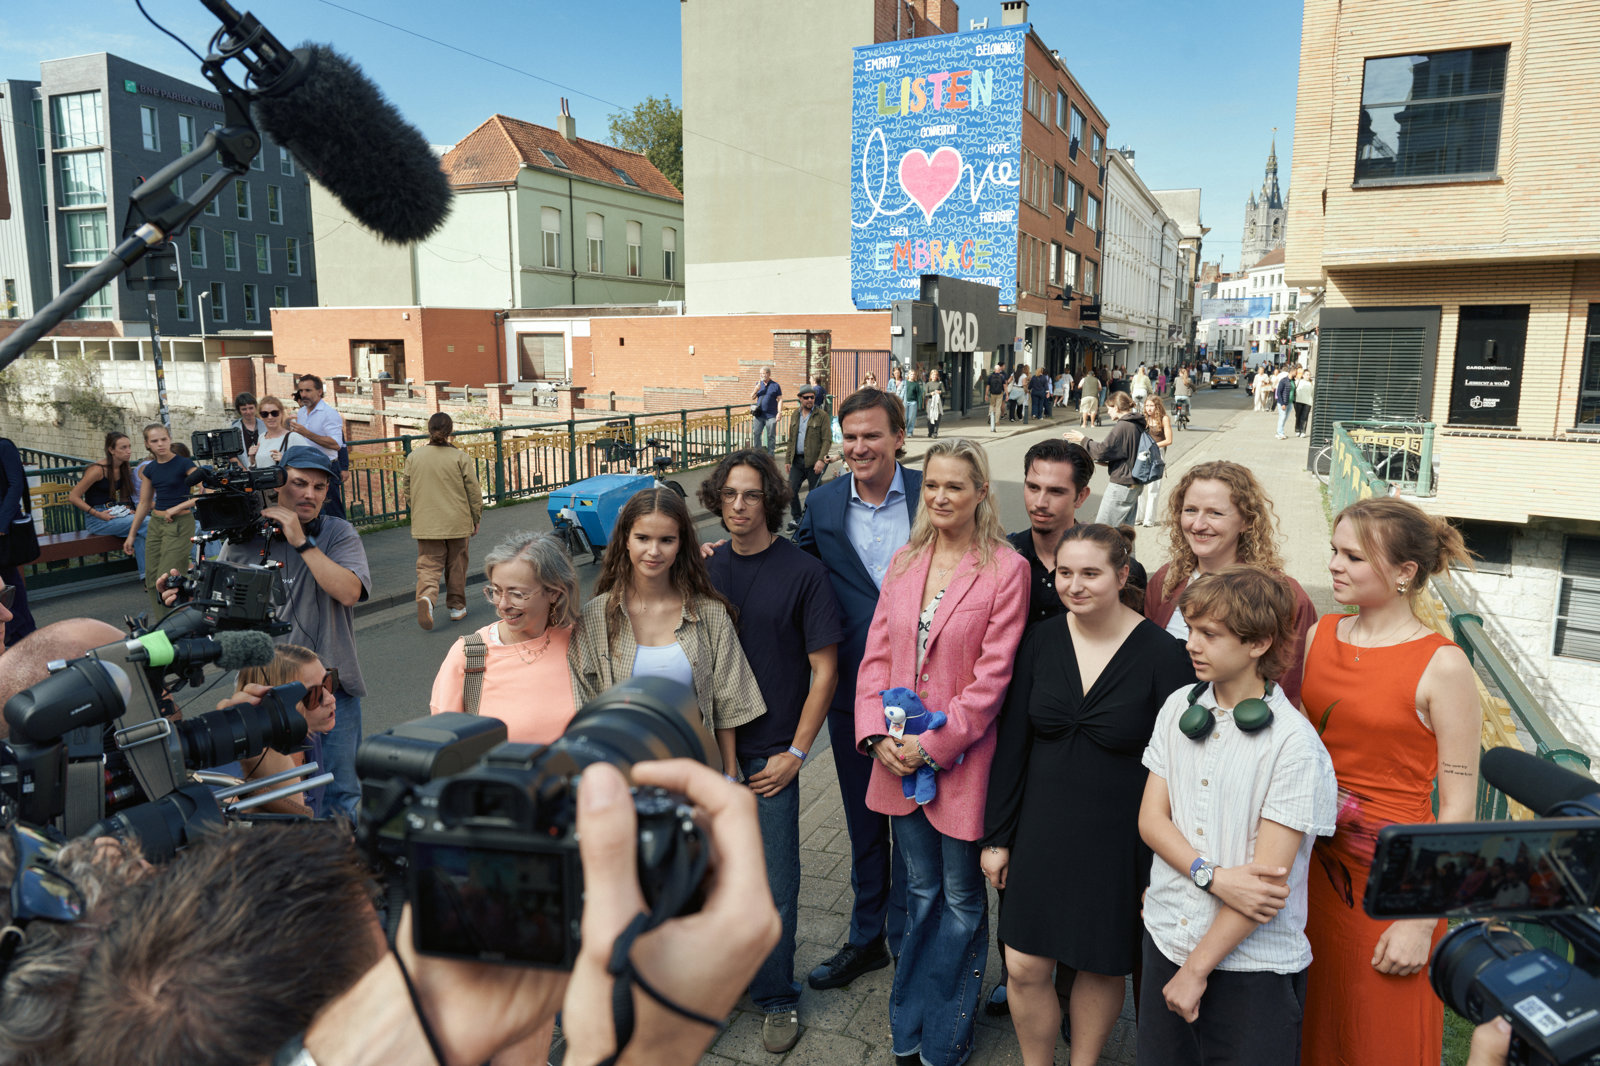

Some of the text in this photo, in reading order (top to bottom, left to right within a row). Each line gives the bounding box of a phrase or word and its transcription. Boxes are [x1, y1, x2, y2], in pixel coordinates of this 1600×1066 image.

[975, 42, 1016, 56] BELONGING
[865, 55, 901, 71] EMPATHY
[140, 84, 225, 111] BNP PARIBAS FORTI
[878, 68, 993, 116] LISTEN
[920, 124, 957, 138] CONNECTION
[987, 143, 1011, 155] HOPE
[979, 211, 1015, 223] FRIENDSHIP
[889, 226, 909, 236] SEEN
[875, 239, 993, 271] EMBRACE
[940, 309, 979, 352] Y&D
